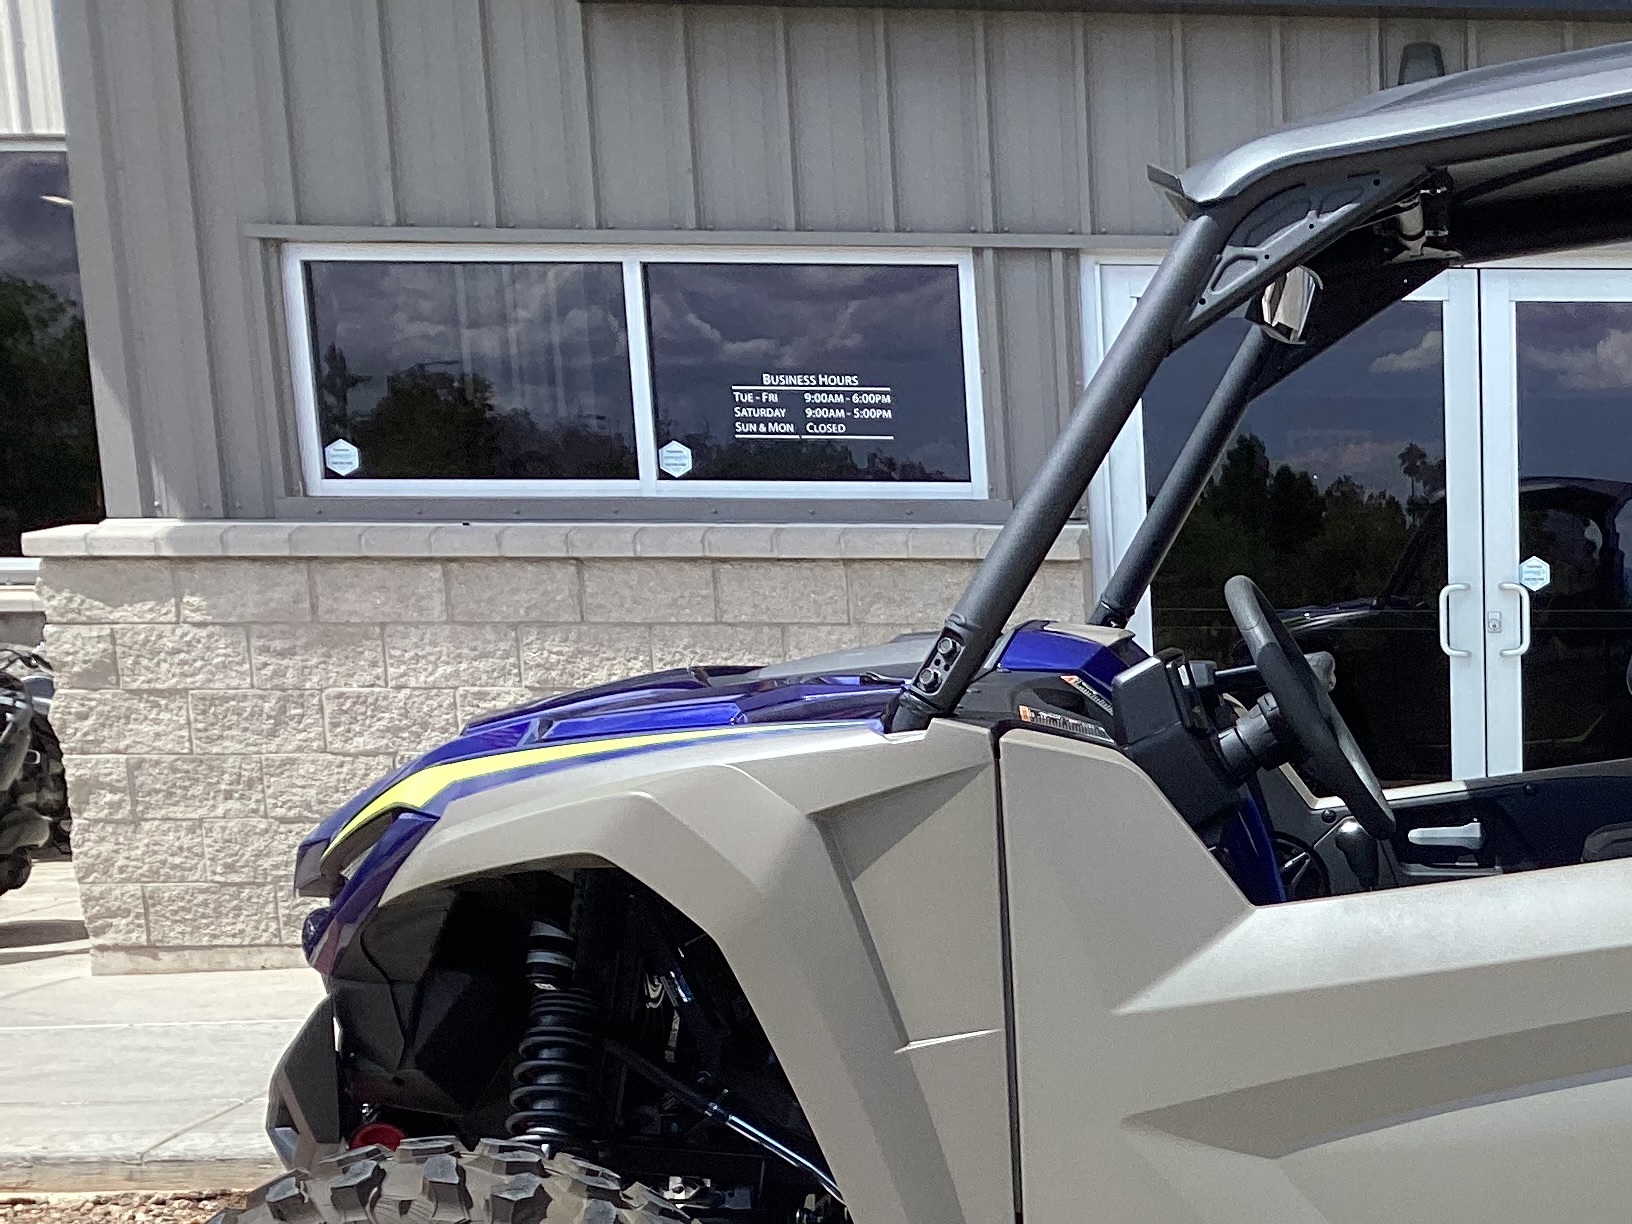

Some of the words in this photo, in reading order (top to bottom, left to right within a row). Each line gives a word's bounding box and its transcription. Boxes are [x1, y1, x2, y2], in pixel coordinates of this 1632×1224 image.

[762, 373, 816, 386] BUSINESS
[818, 374, 859, 386] HOURS
[733, 392, 753, 402] TUE
[761, 392, 778, 402] FRI
[803, 393, 844, 403] 9:00AM
[852, 393, 891, 404] 6:00PM
[734, 407, 786, 418] SATURDAY
[804, 408, 845, 418] 9:00AM
[853, 408, 892, 419] 5:00PM
[735, 422, 757, 433] SUN
[759, 422, 766, 432] &
[768, 422, 795, 433] MON
[806, 422, 846, 433] CLOSED
